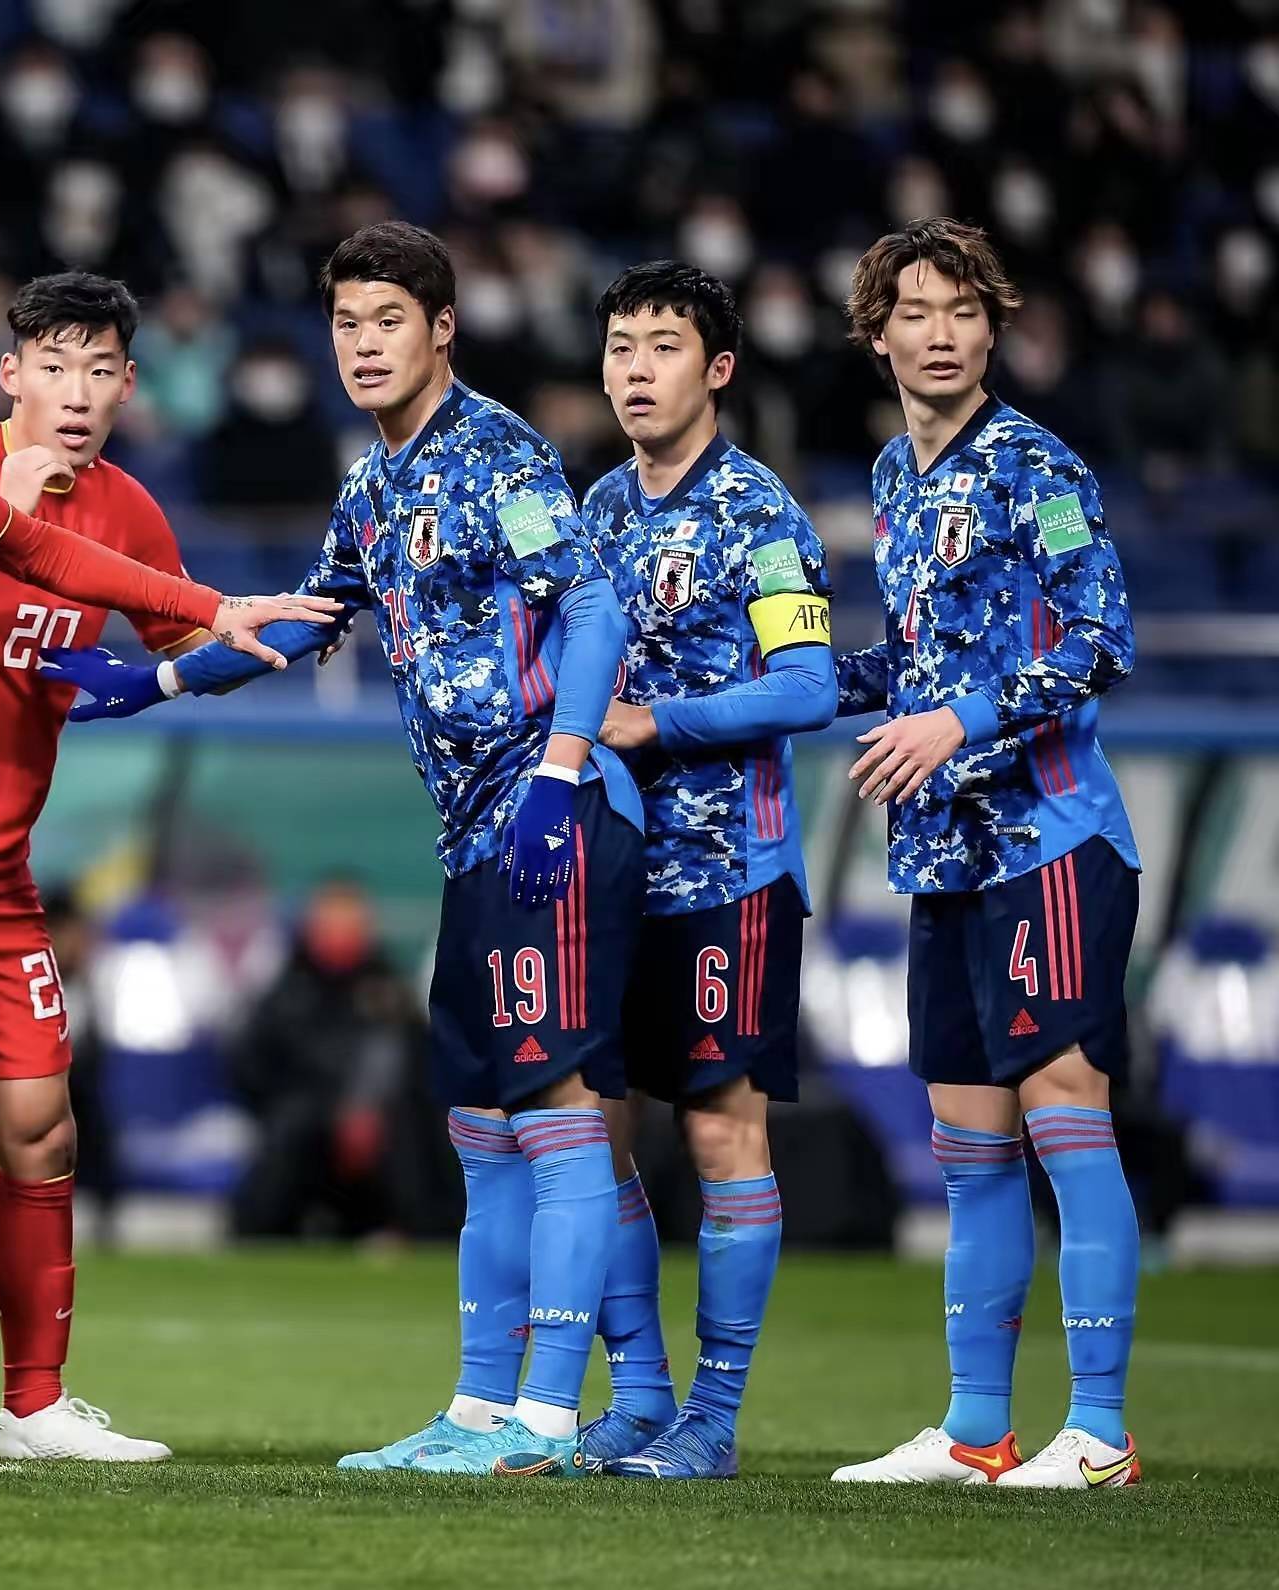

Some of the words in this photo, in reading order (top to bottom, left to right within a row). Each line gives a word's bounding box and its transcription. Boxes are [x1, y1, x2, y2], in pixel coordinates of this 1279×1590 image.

[3, 603, 82, 670] 20
[21, 946, 65, 1020] 2
[487, 946, 547, 1027] 19
[695, 945, 729, 1023] 6
[1009, 919, 1038, 996] 4
[514, 1050, 550, 1063] adidas
[688, 1050, 725, 1061] adidas
[1008, 1024, 1039, 1036] adidas
[529, 1307, 590, 1323] JAPAN
